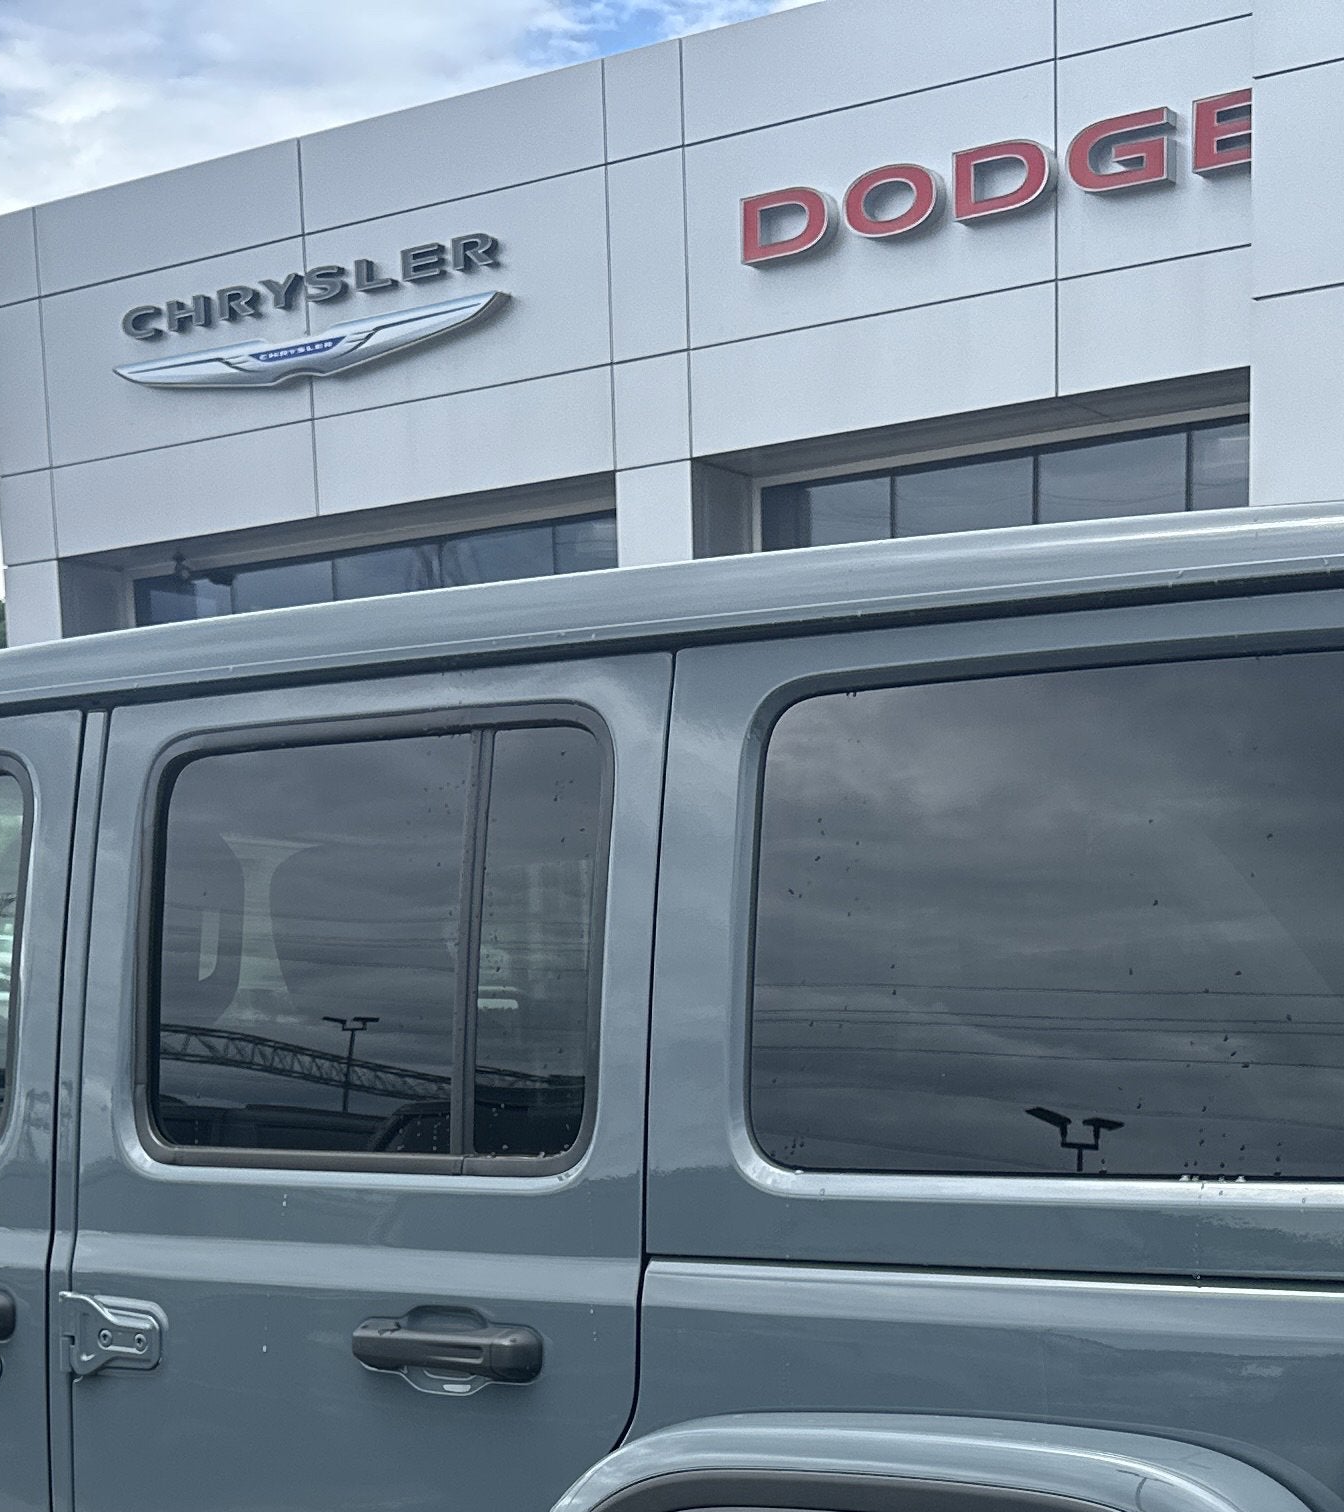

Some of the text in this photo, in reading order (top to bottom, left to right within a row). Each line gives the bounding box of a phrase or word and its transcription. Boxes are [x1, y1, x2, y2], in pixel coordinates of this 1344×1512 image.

[738, 88, 1252, 268] DODGE
[120, 231, 504, 342] CHRYSLER
[258, 341, 333, 360] CHRYSLER
